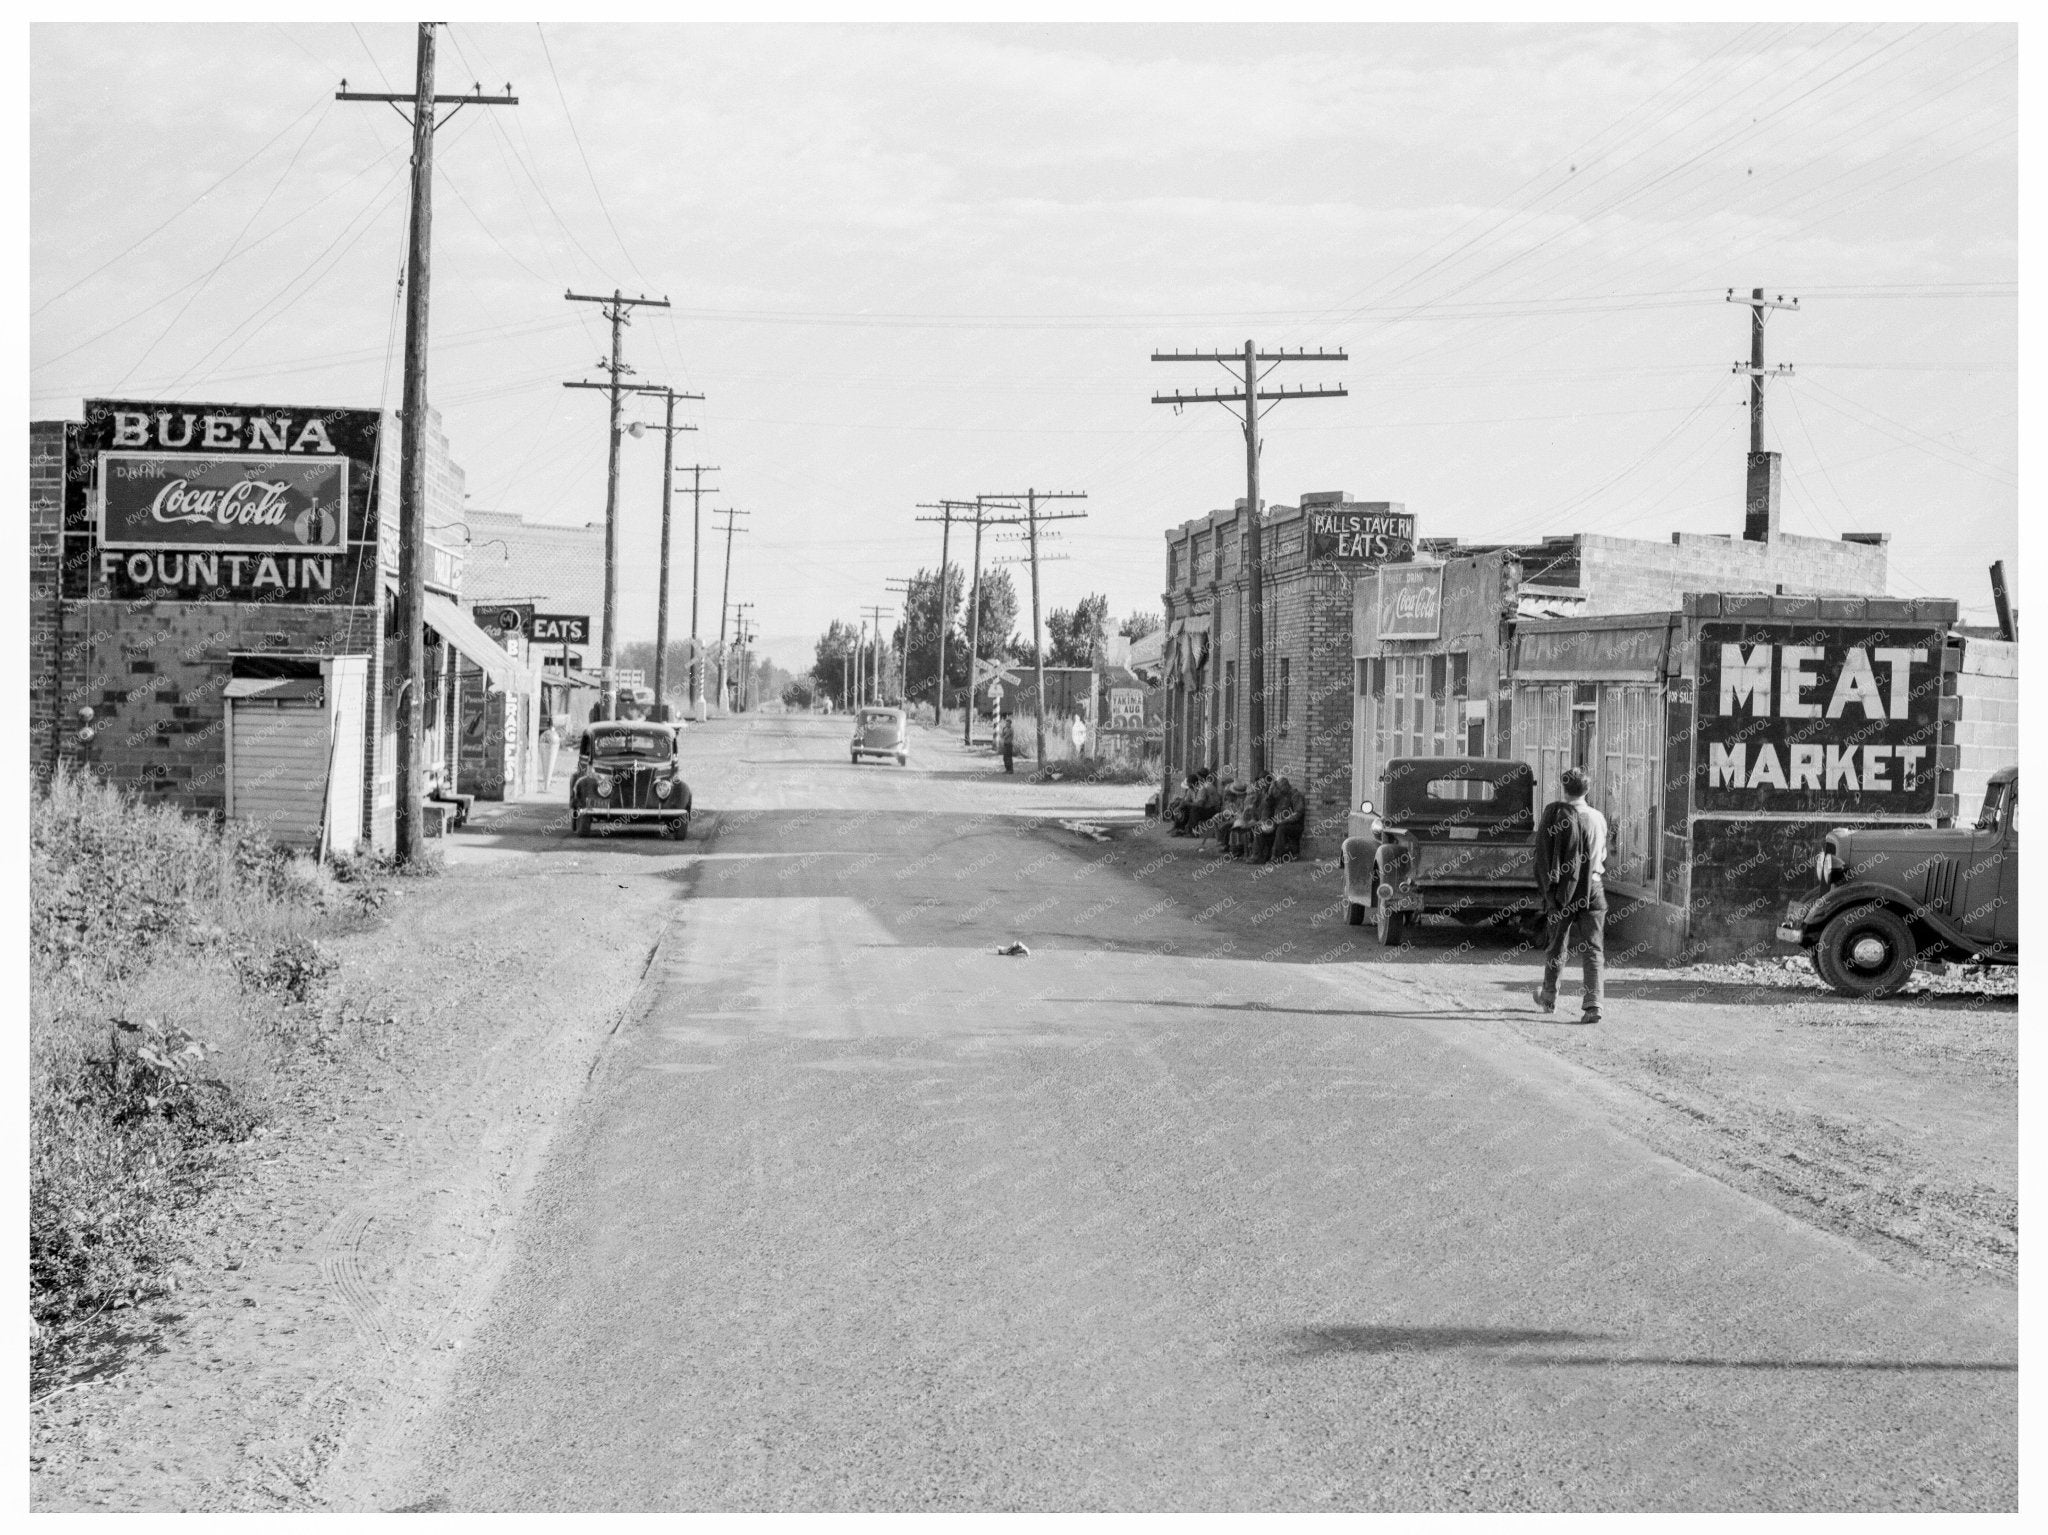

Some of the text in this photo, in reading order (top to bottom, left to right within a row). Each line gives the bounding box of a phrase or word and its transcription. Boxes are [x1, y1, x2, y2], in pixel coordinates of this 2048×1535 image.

[112, 411, 336, 453] BUENA
[116, 466, 166, 480] DRINK
[152, 479, 293, 526] Coca-Cola
[1363, 517, 1412, 539] TAVERN
[1338, 533, 1389, 557] EATS
[100, 553, 332, 590] FOUNTAIN
[1396, 586, 1438, 619] Coca-Cola
[534, 619, 583, 640] EATS
[1718, 643, 1928, 720] MEAT
[1112, 696, 1142, 705] YAKIMA
[1124, 705, 1141, 714] AUG
[1709, 742, 1927, 793] MARKET
